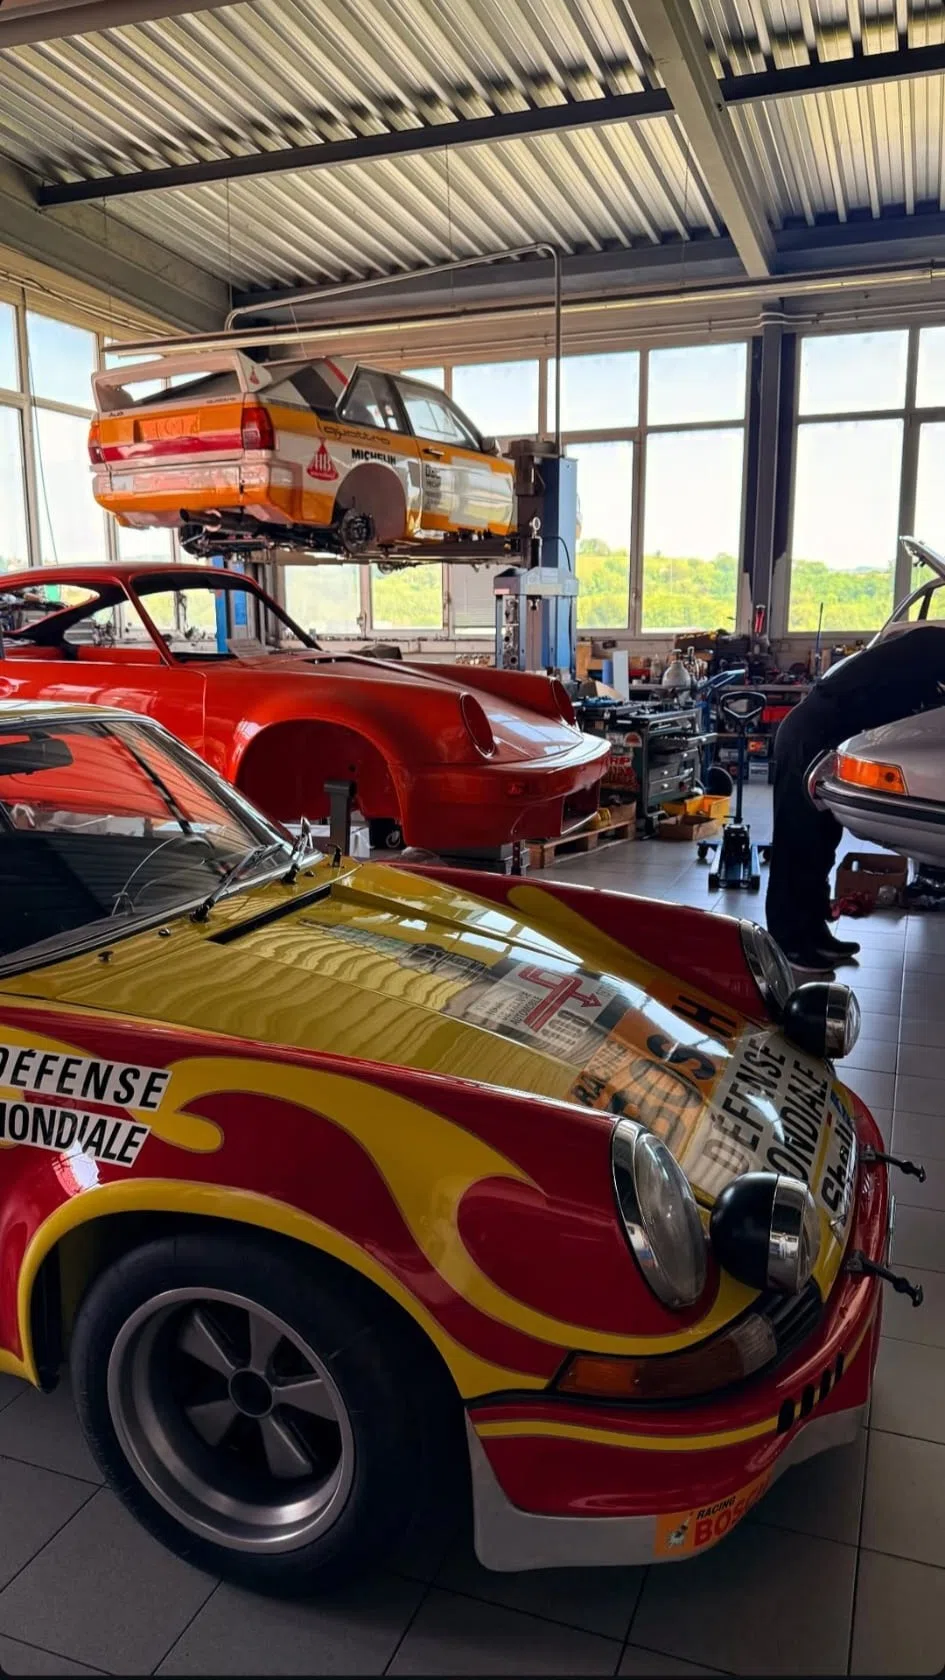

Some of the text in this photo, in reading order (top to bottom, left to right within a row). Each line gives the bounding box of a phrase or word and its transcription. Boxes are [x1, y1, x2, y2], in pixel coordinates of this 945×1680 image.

[351, 448, 397, 464] MICHELIN
[608, 994, 738, 1143] BOSH
[701, 1038, 787, 1174] DÉFENSE
[763, 1060, 828, 1184] ONDIALE
[696, 1495, 737, 1520] RACING
